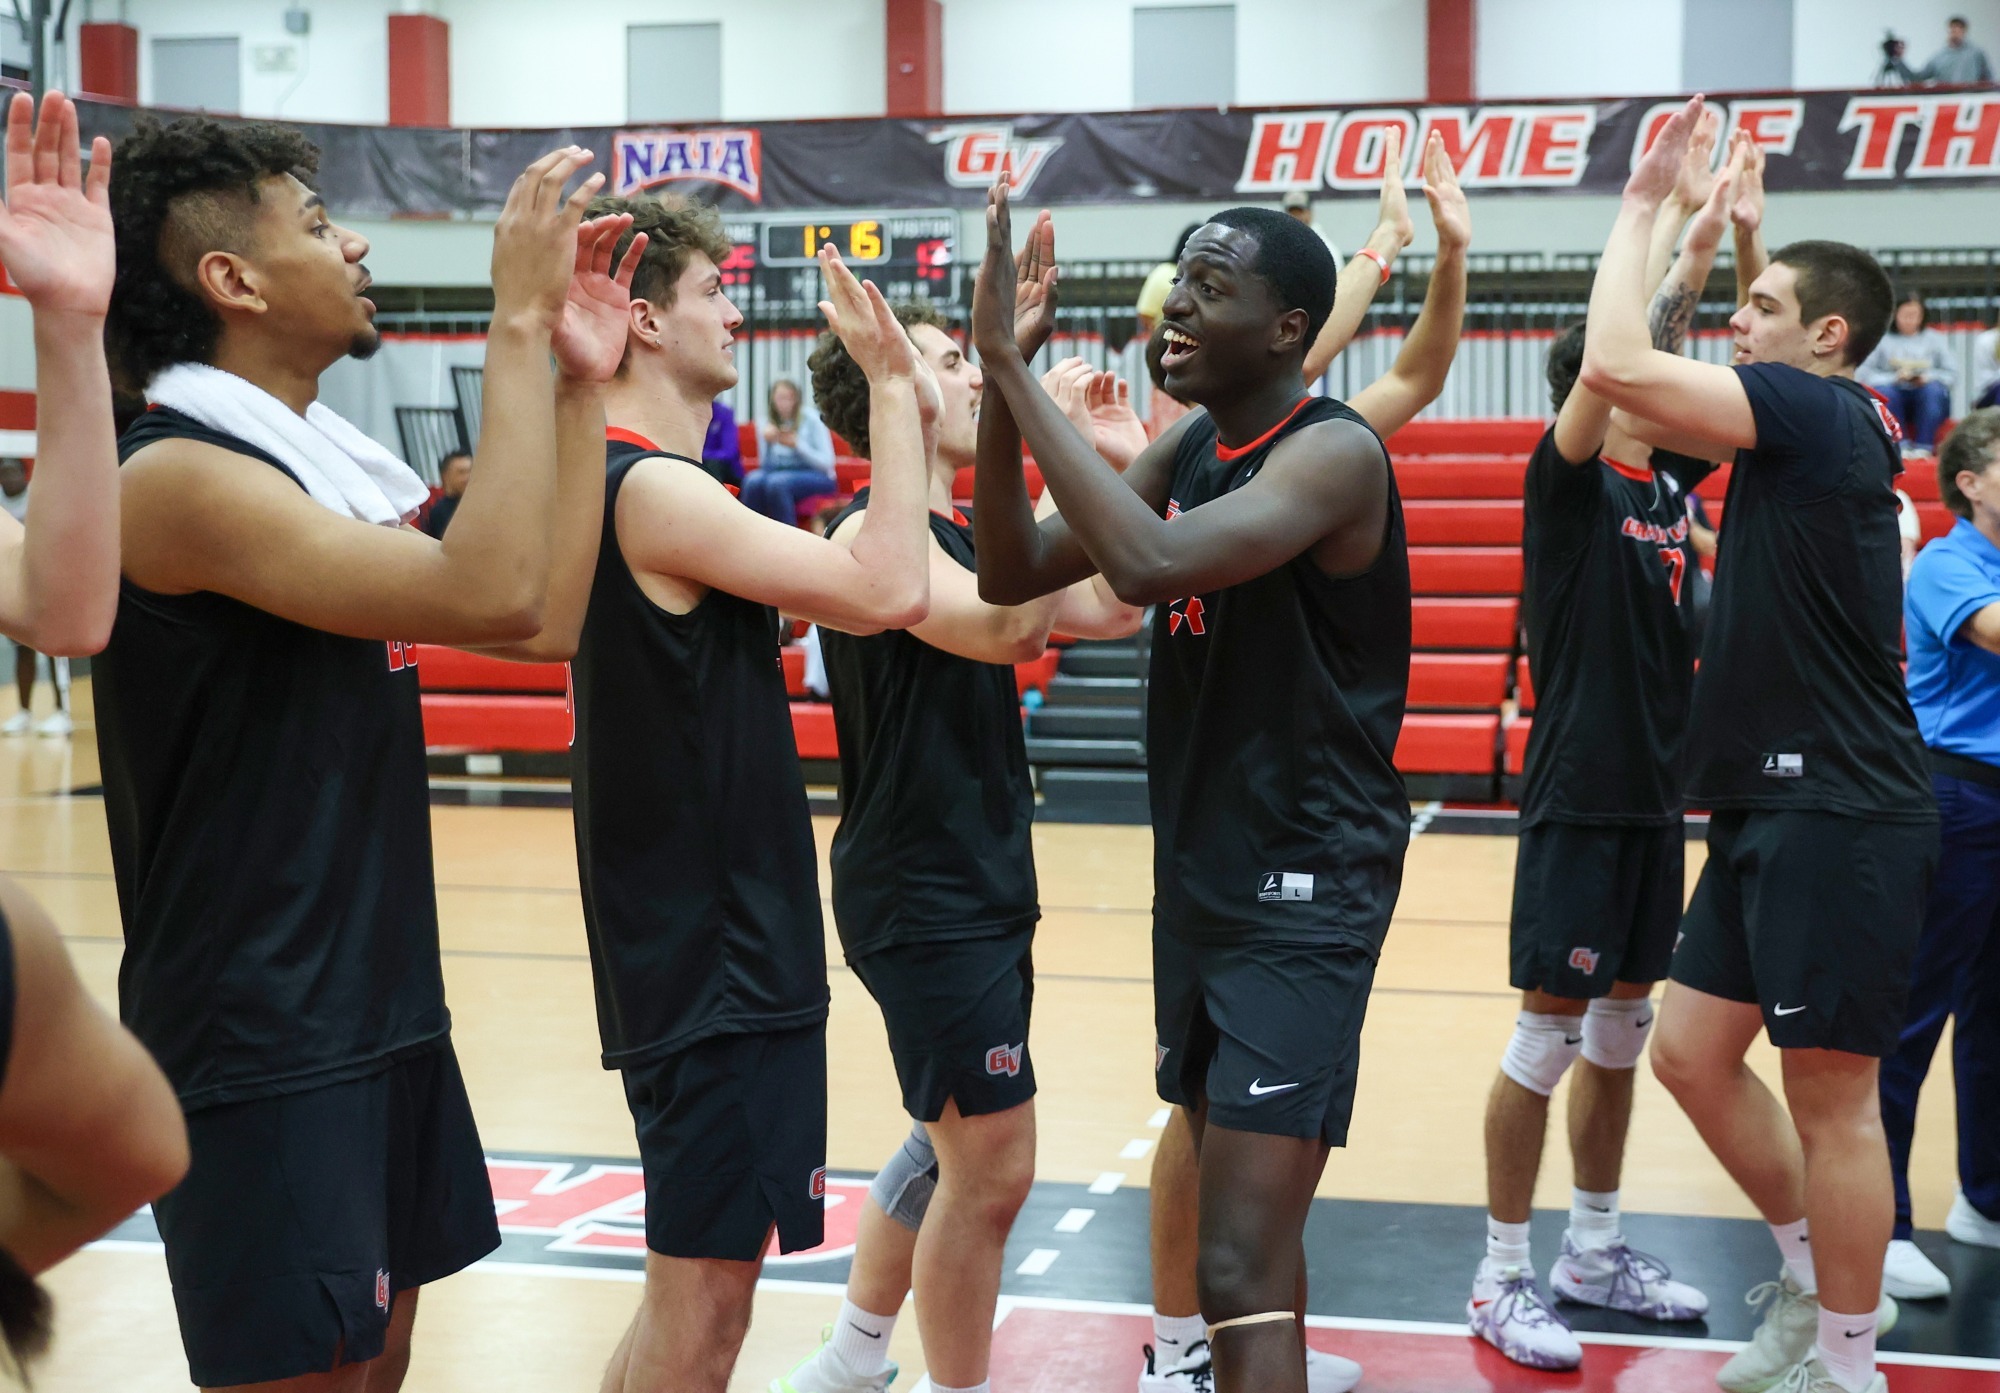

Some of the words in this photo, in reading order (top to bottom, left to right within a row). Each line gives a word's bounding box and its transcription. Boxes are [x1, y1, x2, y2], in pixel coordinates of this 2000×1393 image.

[616, 133, 757, 195] NAIA
[928, 122, 1066, 201] GV
[1234, 105, 1597, 193] HOME
[1837, 94, 2000, 181] TH
[1658, 547, 1686, 606] 7
[1294, 888, 1301, 898] L
[1568, 946, 1600, 975] GV
[985, 1042, 1024, 1078] GV
[809, 1165, 826, 1200] G
